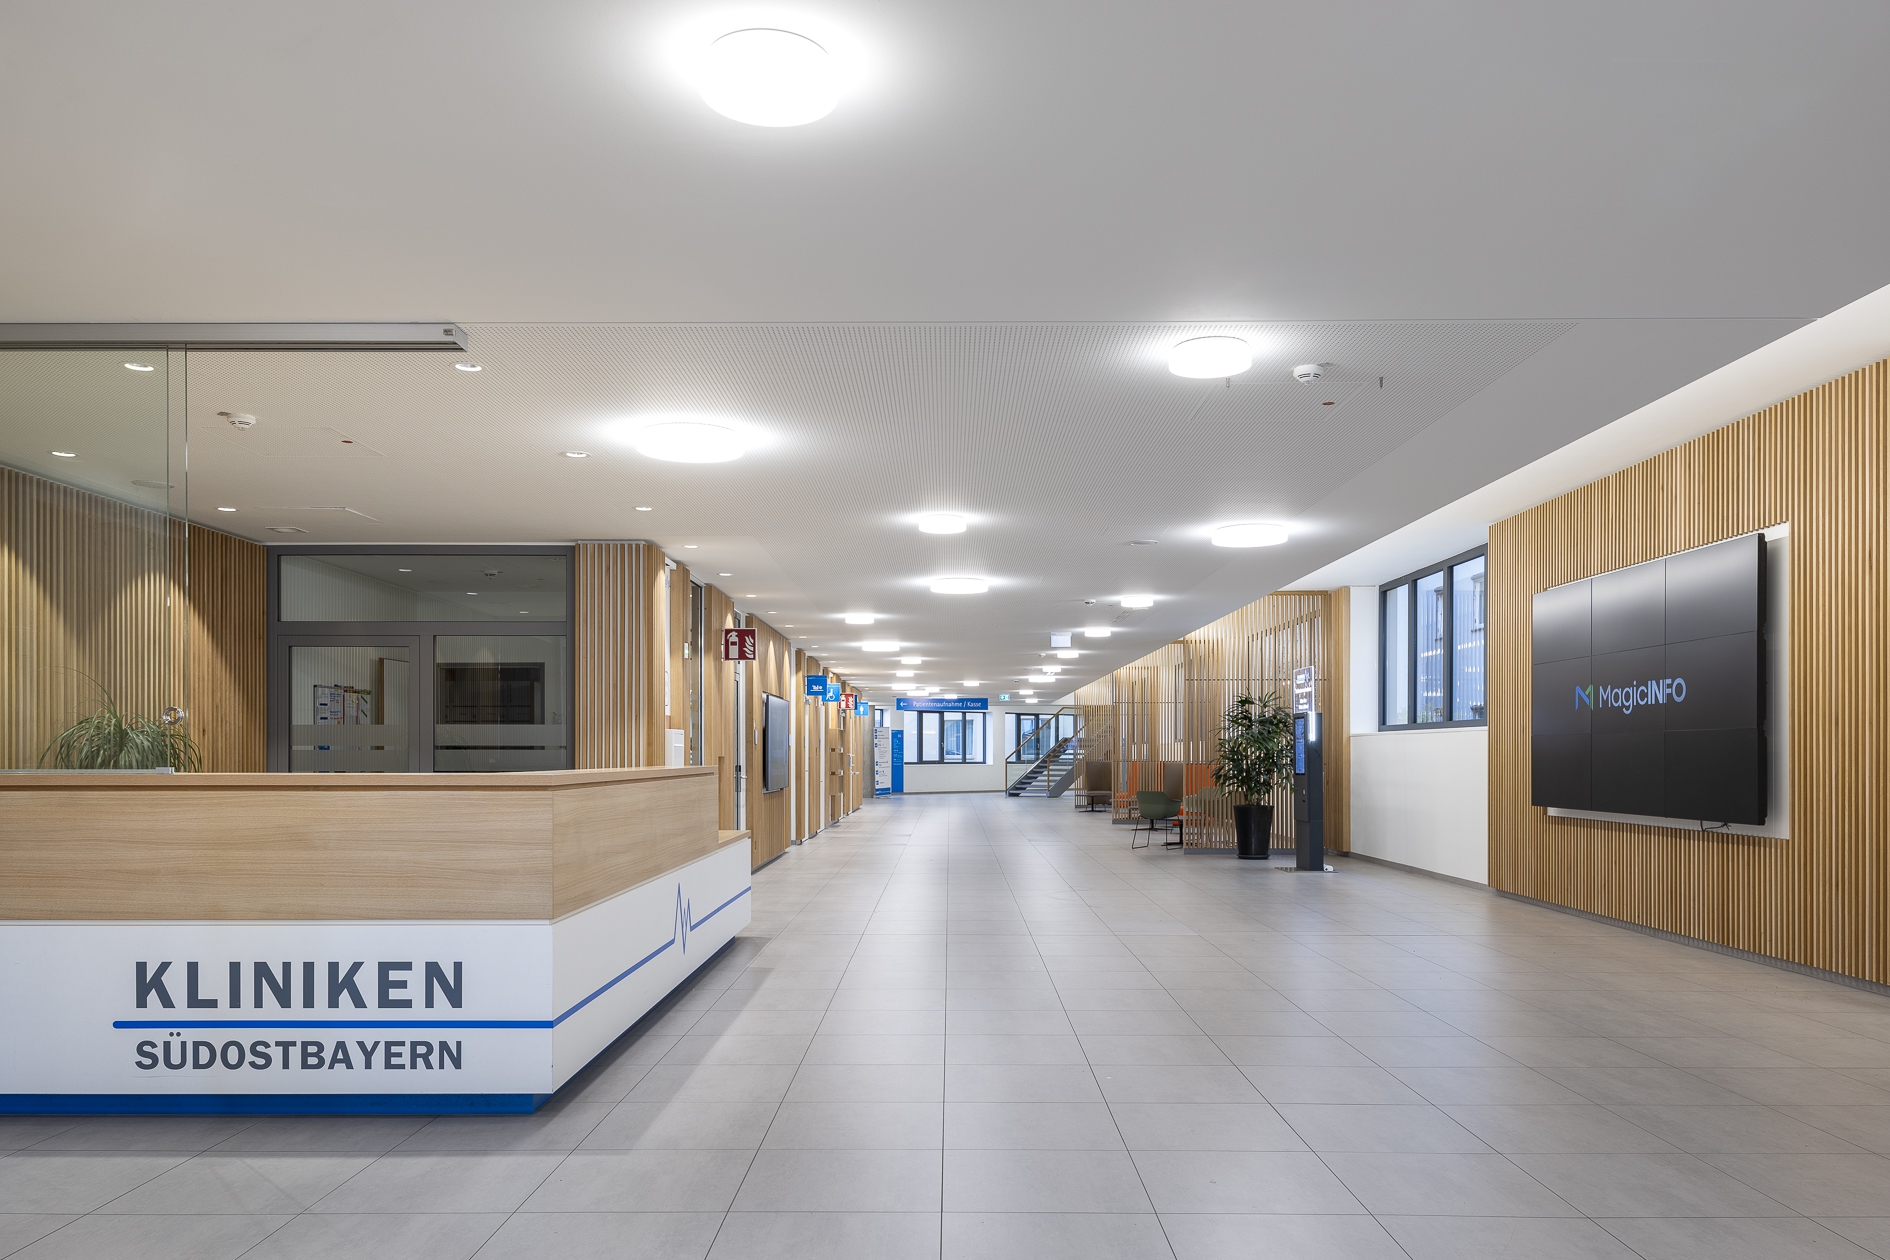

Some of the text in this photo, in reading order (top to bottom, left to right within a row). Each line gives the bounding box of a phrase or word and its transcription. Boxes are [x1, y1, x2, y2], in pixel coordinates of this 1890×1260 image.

[1599, 677, 1686, 715] MagicINFO
[135, 961, 463, 1009] KLINIKEN
[135, 1031, 463, 1071] SÜDOSTBAYERN
